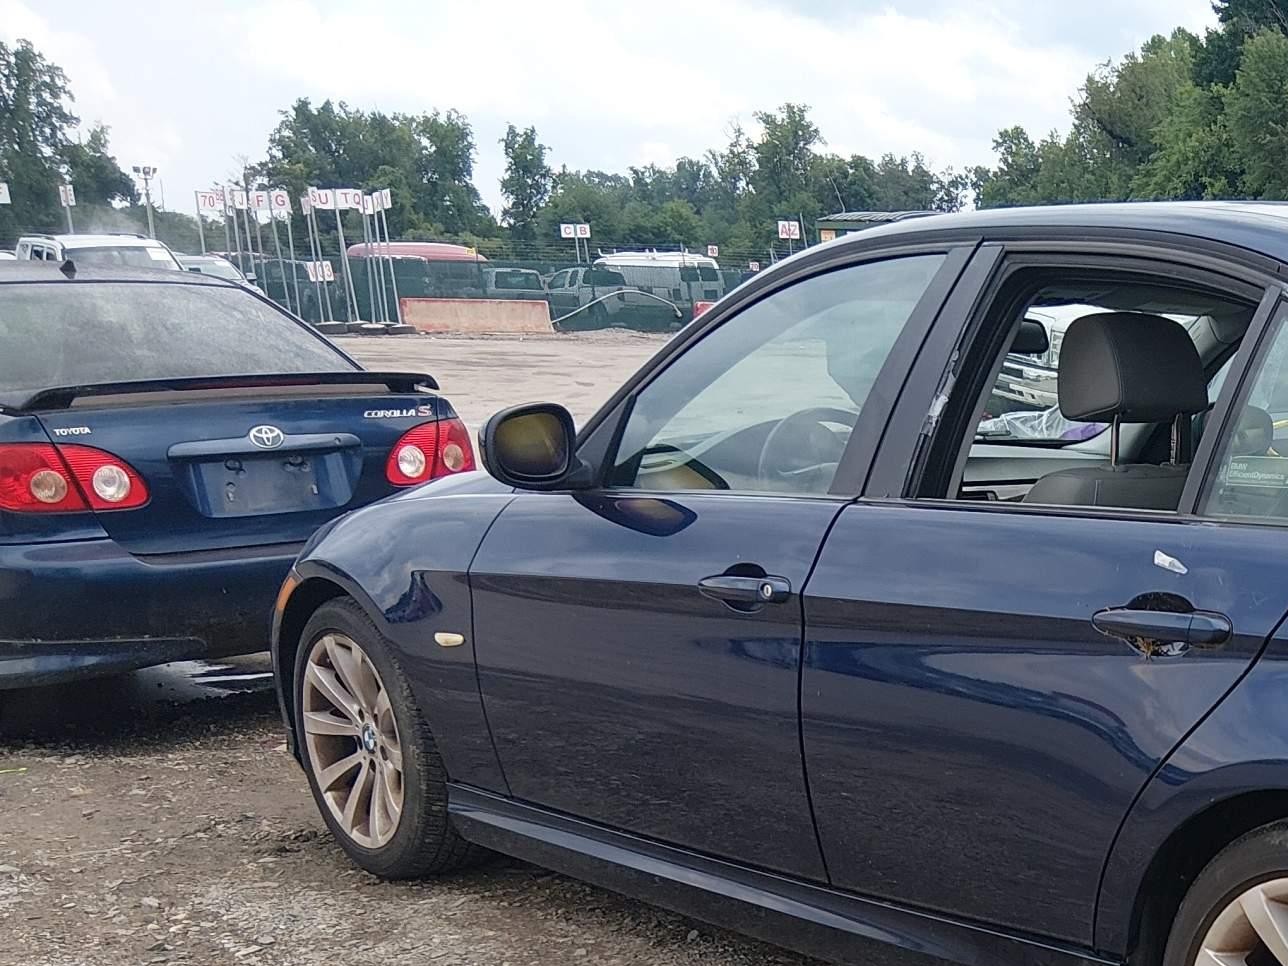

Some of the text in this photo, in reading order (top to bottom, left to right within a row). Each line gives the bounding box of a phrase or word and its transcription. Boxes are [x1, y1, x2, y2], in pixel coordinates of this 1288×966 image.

[200, 195, 215, 208] 70
[256, 195, 264, 207] F
[275, 194, 286, 206] G
[318, 192, 329, 205] U
[340, 192, 350, 204] T
[564, 226, 572, 235] C
[579, 226, 587, 235] B
[363, 403, 433, 418] COROLLA S
[53, 426, 92, 436] TOYOTA
